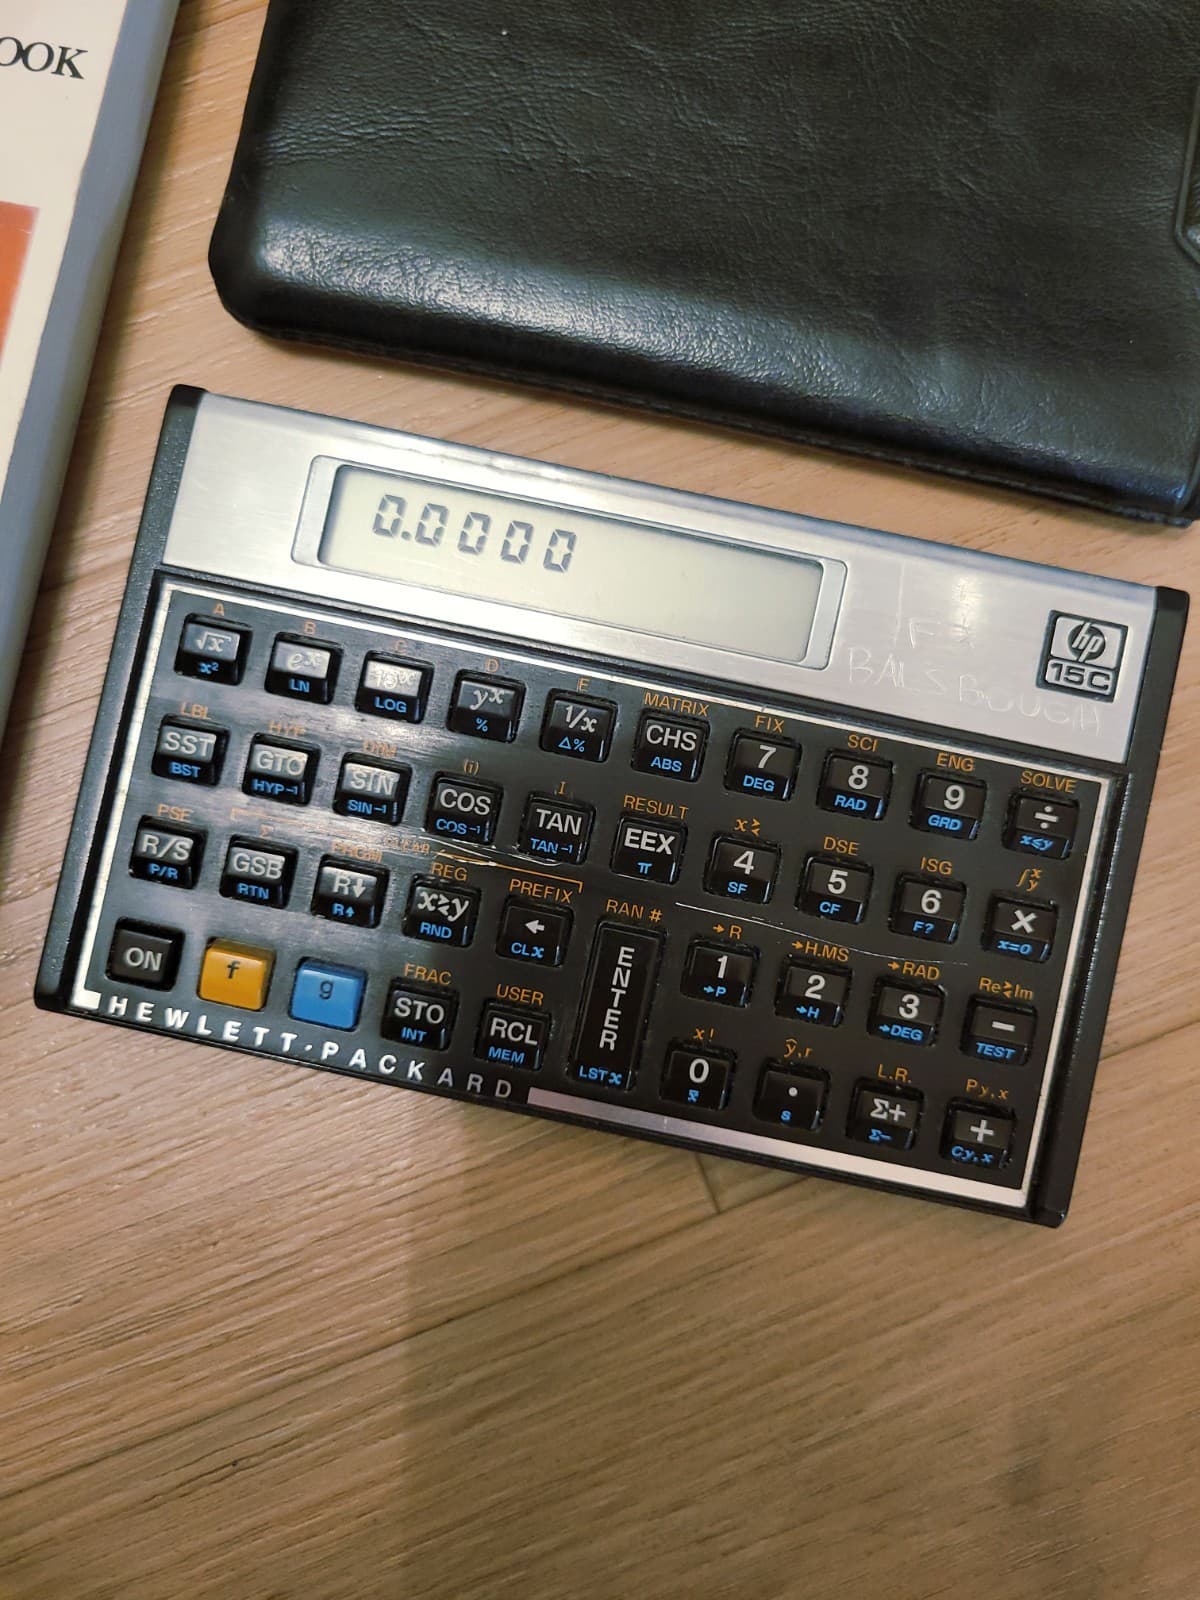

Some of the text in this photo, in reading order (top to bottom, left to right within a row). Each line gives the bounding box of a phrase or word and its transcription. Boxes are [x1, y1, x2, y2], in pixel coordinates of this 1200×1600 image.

[372, 494, 577, 573] 0.0000
[213, 603, 225, 616] A
[304, 621, 316, 635] B
[485, 659, 499, 672] D
[289, 678, 310, 693] LN
[577, 677, 591, 693] E
[1050, 663, 1111, 691] 15C
[180, 701, 210, 719] LBL
[375, 696, 407, 713] LOG
[644, 692, 710, 717] MATRIX
[565, 704, 598, 733] 1/x
[755, 715, 785, 733] FIX
[164, 732, 216, 757] SST
[646, 724, 698, 751] CHS
[847, 734, 878, 752] SCI
[256, 750, 305, 776] GTO
[650, 756, 682, 773] ABS
[758, 745, 776, 769] 7
[936, 752, 976, 773] ENG
[171, 761, 201, 778] BST
[847, 765, 869, 790] 8
[351, 770, 394, 795] SIN
[743, 775, 776, 792] DEG
[1020, 770, 1078, 794] SOLVE
[440, 789, 491, 816] COS
[624, 794, 689, 820] RESULT
[834, 795, 867, 811] RAD
[944, 785, 966, 810] 9
[158, 803, 194, 822] PSE
[536, 808, 582, 836] TAN
[928, 814, 963, 831] GRD
[143, 834, 192, 861] R/S
[624, 827, 676, 855] EEX
[823, 836, 860, 856] DSE
[150, 864, 178, 879] P/R
[233, 853, 282, 879] GSB
[431, 862, 468, 881] REG
[733, 851, 754, 875] 4
[921, 856, 953, 876] ISG
[237, 883, 270, 899] RTN
[509, 878, 573, 904] PREFIX
[727, 881, 748, 895] SF
[827, 869, 848, 895] 5
[605, 899, 644, 919] RAN
[819, 901, 841, 915] CF
[921, 889, 942, 914] 6
[420, 922, 452, 938] RND
[912, 921, 935, 934] F?
[126, 947, 163, 971] ON
[226, 960, 240, 979] f
[716, 955, 728, 979] 1
[404, 963, 452, 985] FRAC
[902, 961, 940, 981] RAD
[319, 980, 334, 999] g
[496, 984, 544, 1006] USER
[804, 974, 826, 1000] 2
[600, 946, 635, 1051] ENTER
[898, 994, 921, 1019] 3
[394, 997, 445, 1025] STO
[401, 1026, 427, 1042] INT
[490, 1017, 538, 1045] RCL
[890, 1024, 924, 1041] DEG
[488, 1046, 526, 1063] MEM
[976, 1042, 1016, 1060] TEST
[689, 1058, 709, 1083] 0
